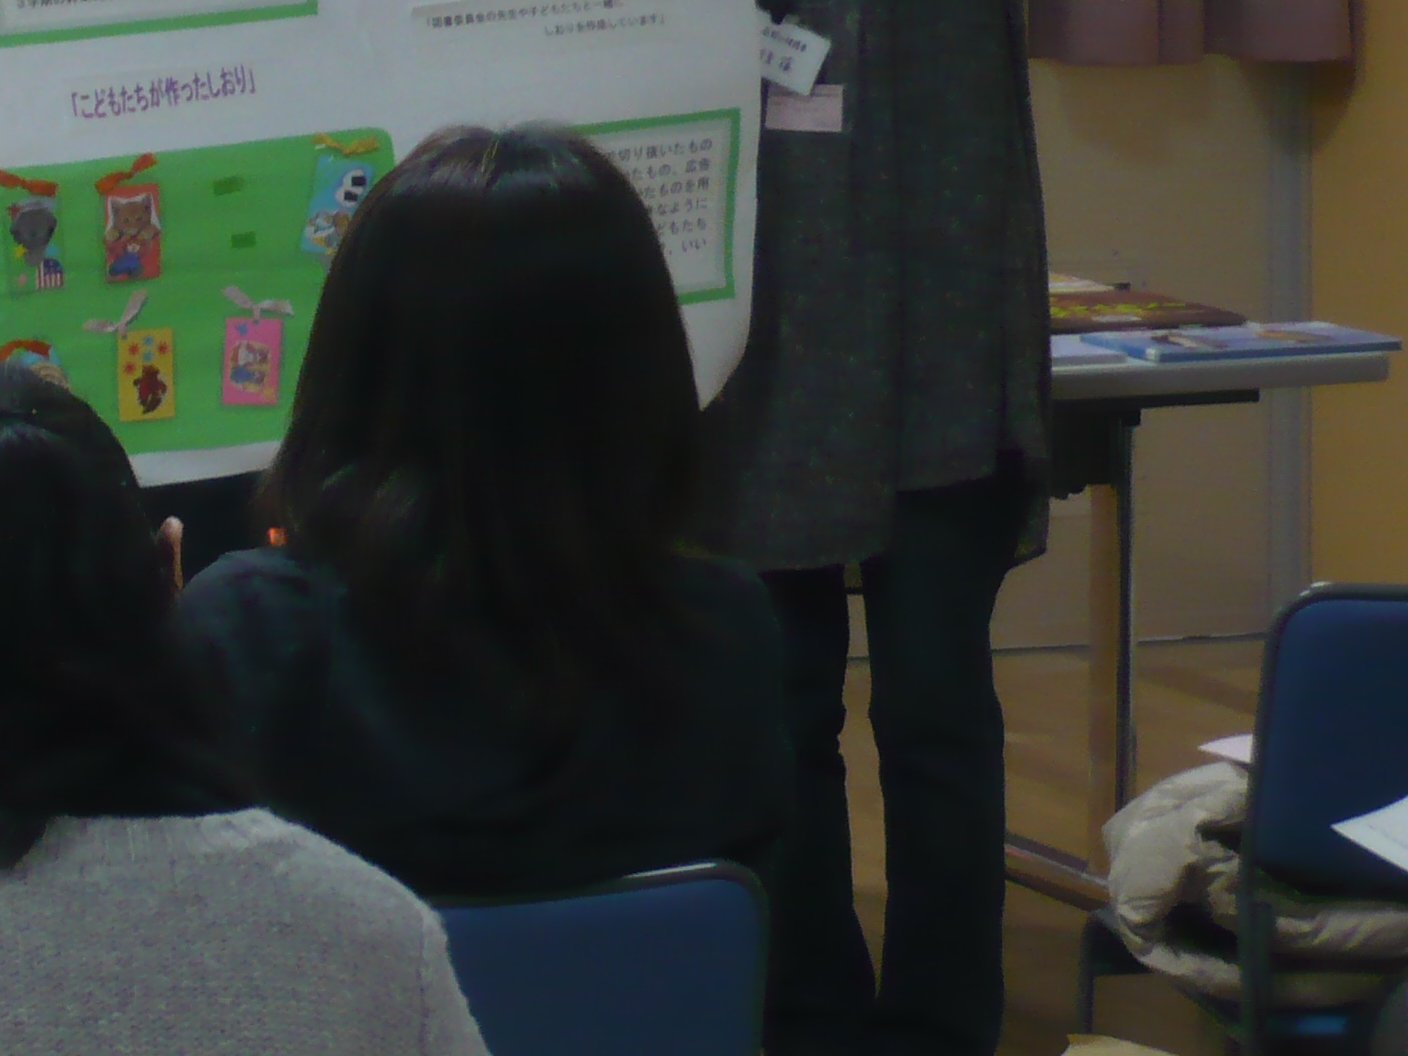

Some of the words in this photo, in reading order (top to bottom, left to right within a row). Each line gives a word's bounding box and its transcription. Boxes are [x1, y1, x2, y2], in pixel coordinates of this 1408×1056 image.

[71, 63, 257, 120] 「こどもたちが作ったしおり」
